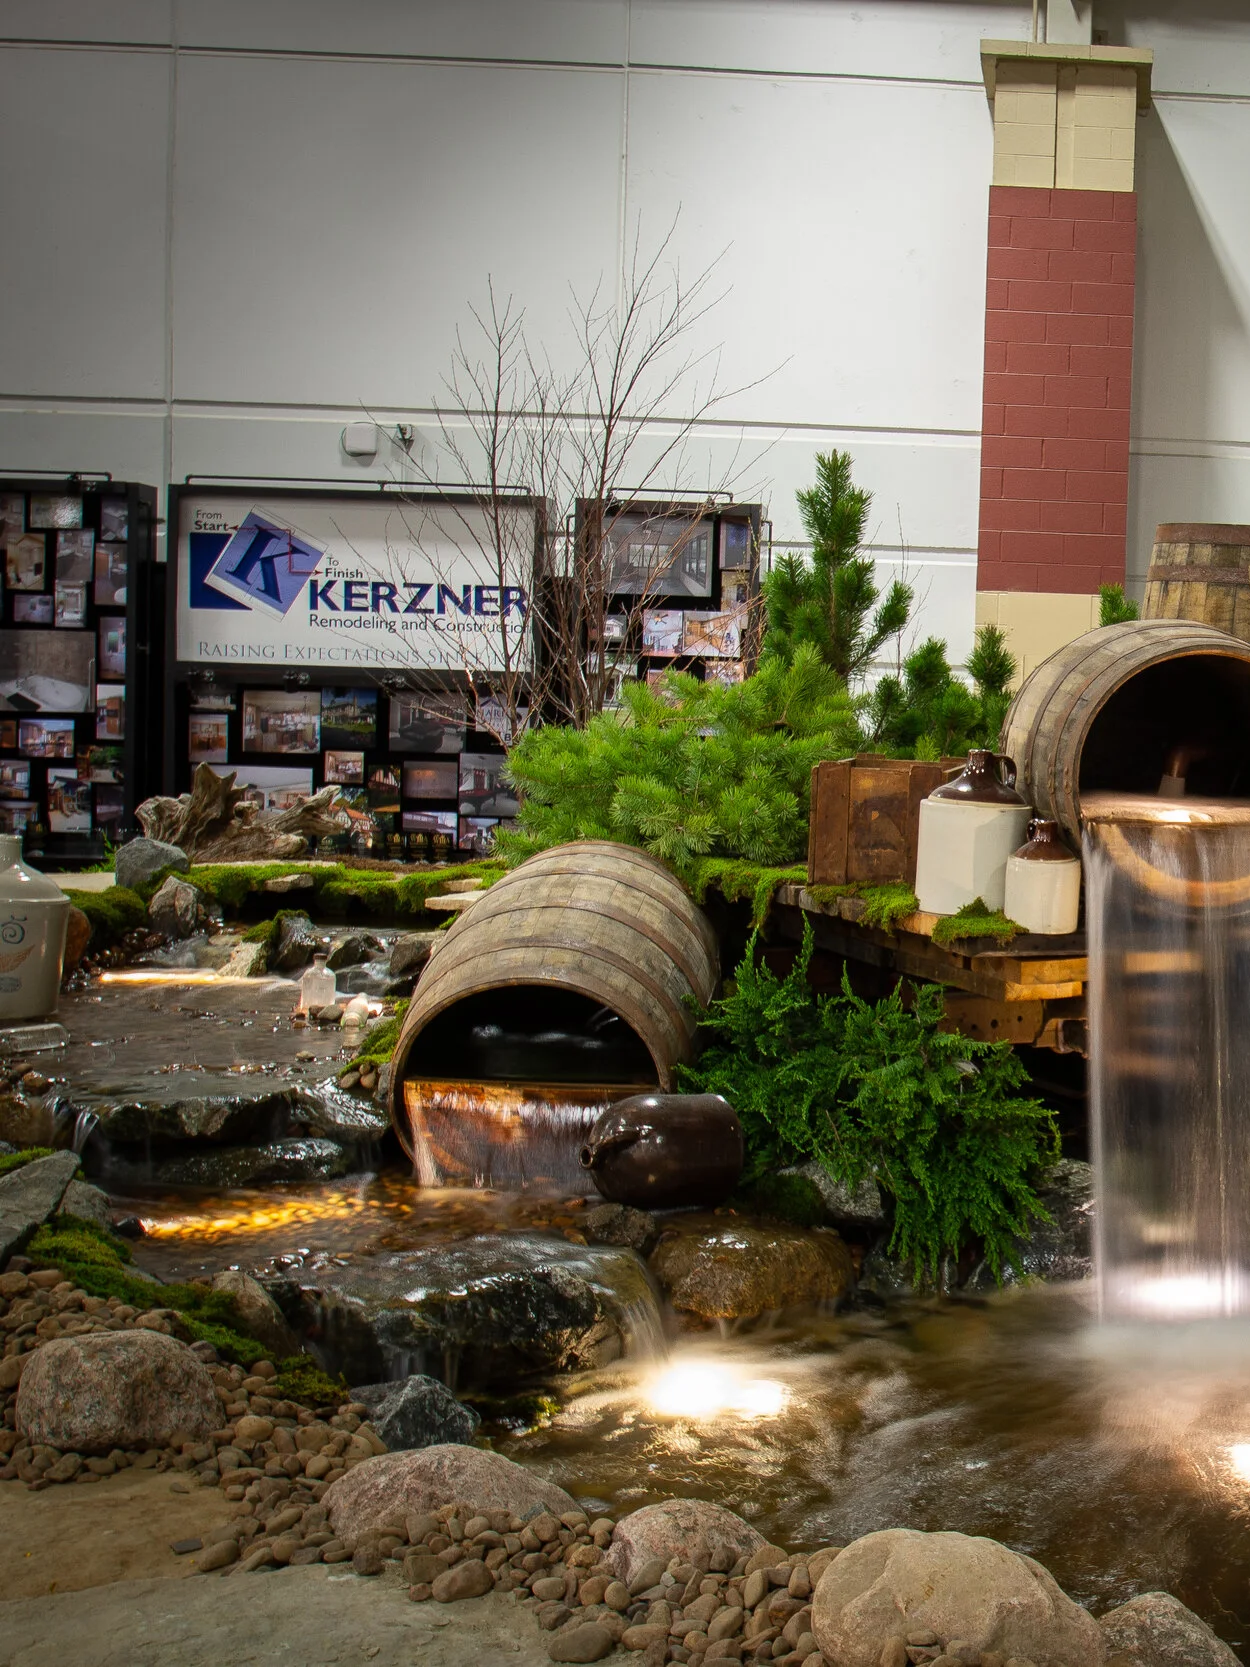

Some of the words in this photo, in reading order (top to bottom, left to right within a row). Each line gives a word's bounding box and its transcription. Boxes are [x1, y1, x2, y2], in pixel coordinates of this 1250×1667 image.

[196, 510, 222, 520] From
[194, 521, 229, 531] Start
[327, 556, 339, 566] To
[325, 568, 363, 579] Finish
[309, 580, 528, 617] KERZNER
[309, 614, 396, 633] Remodeling
[401, 616, 427, 631] and
[199, 641, 275, 659] RAISING
[284, 644, 419, 664] EXPECTATIONS
